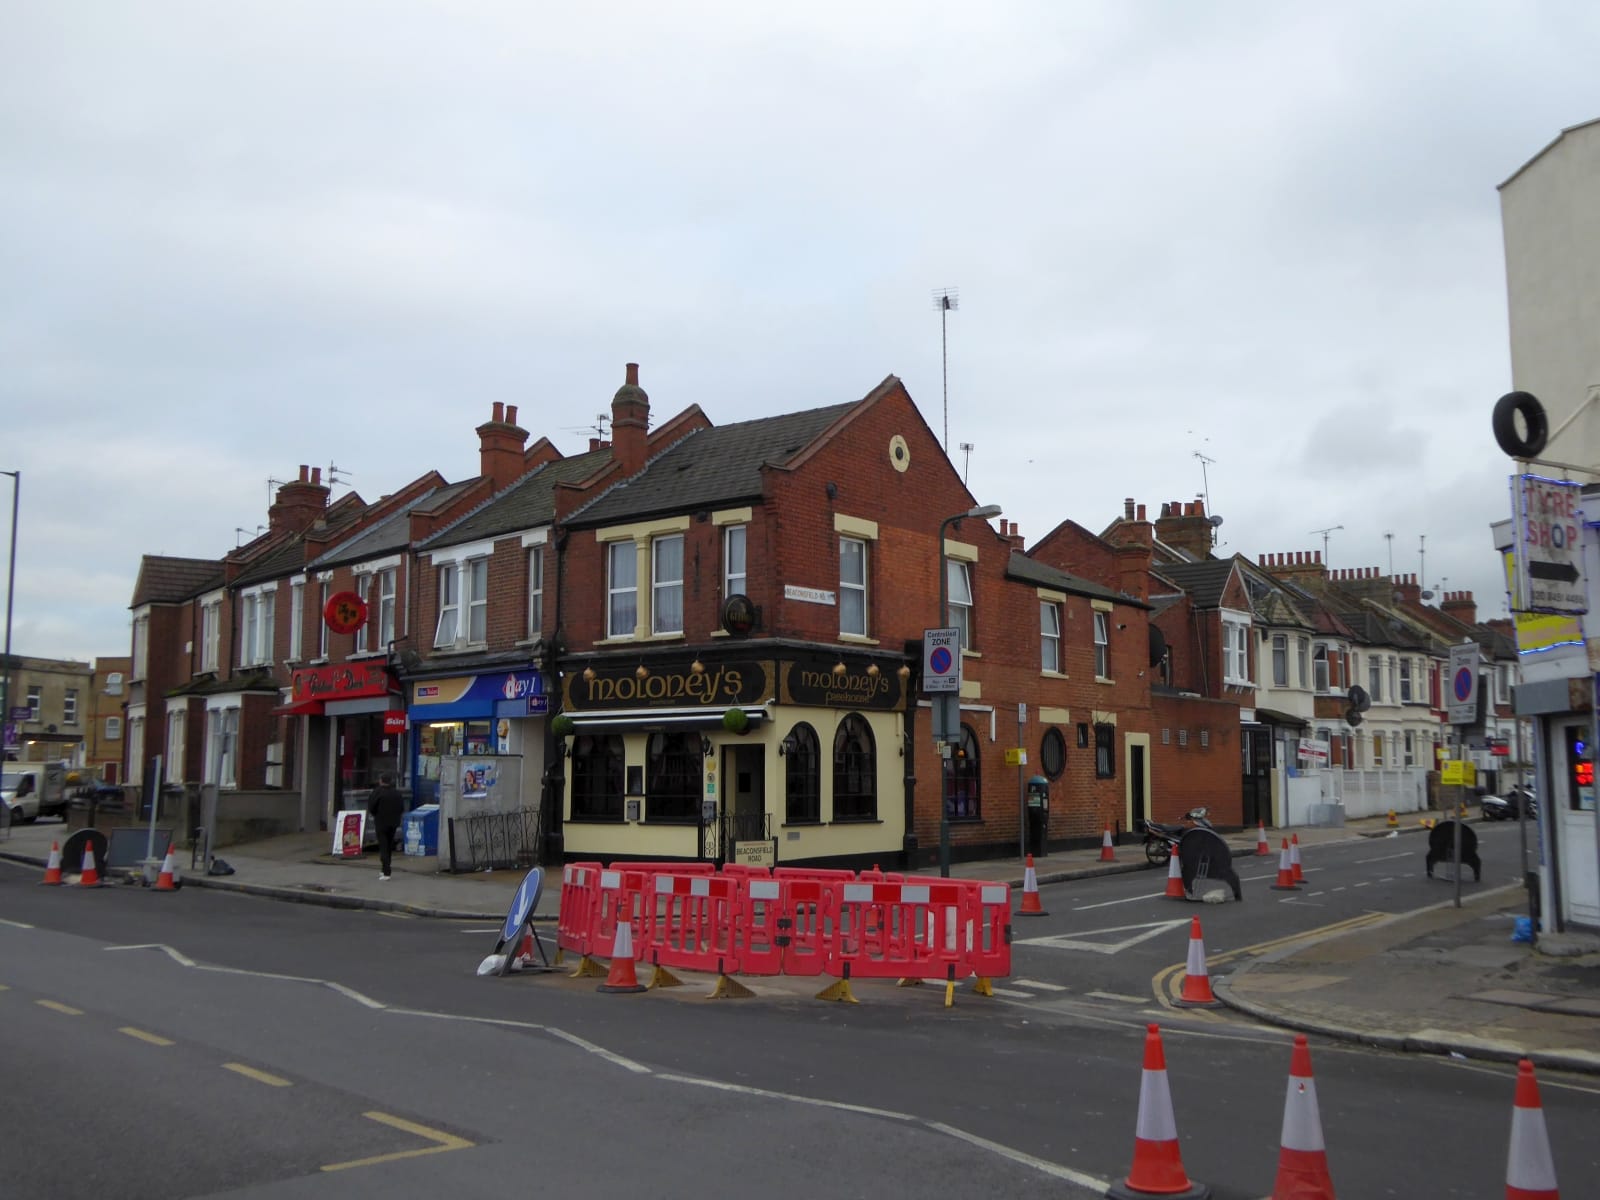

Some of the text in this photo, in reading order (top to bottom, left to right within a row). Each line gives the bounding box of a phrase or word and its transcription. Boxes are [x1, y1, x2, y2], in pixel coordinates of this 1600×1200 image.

[1526, 487, 1576, 519] TYRE
[1528, 521, 1577, 550] SHOP
[786, 588, 819, 600] BEACONSFIELD
[931, 638, 951, 646] ZONE
[736, 847, 773, 856] BEACONSFIELD
[748, 855, 762, 863] ROAD
